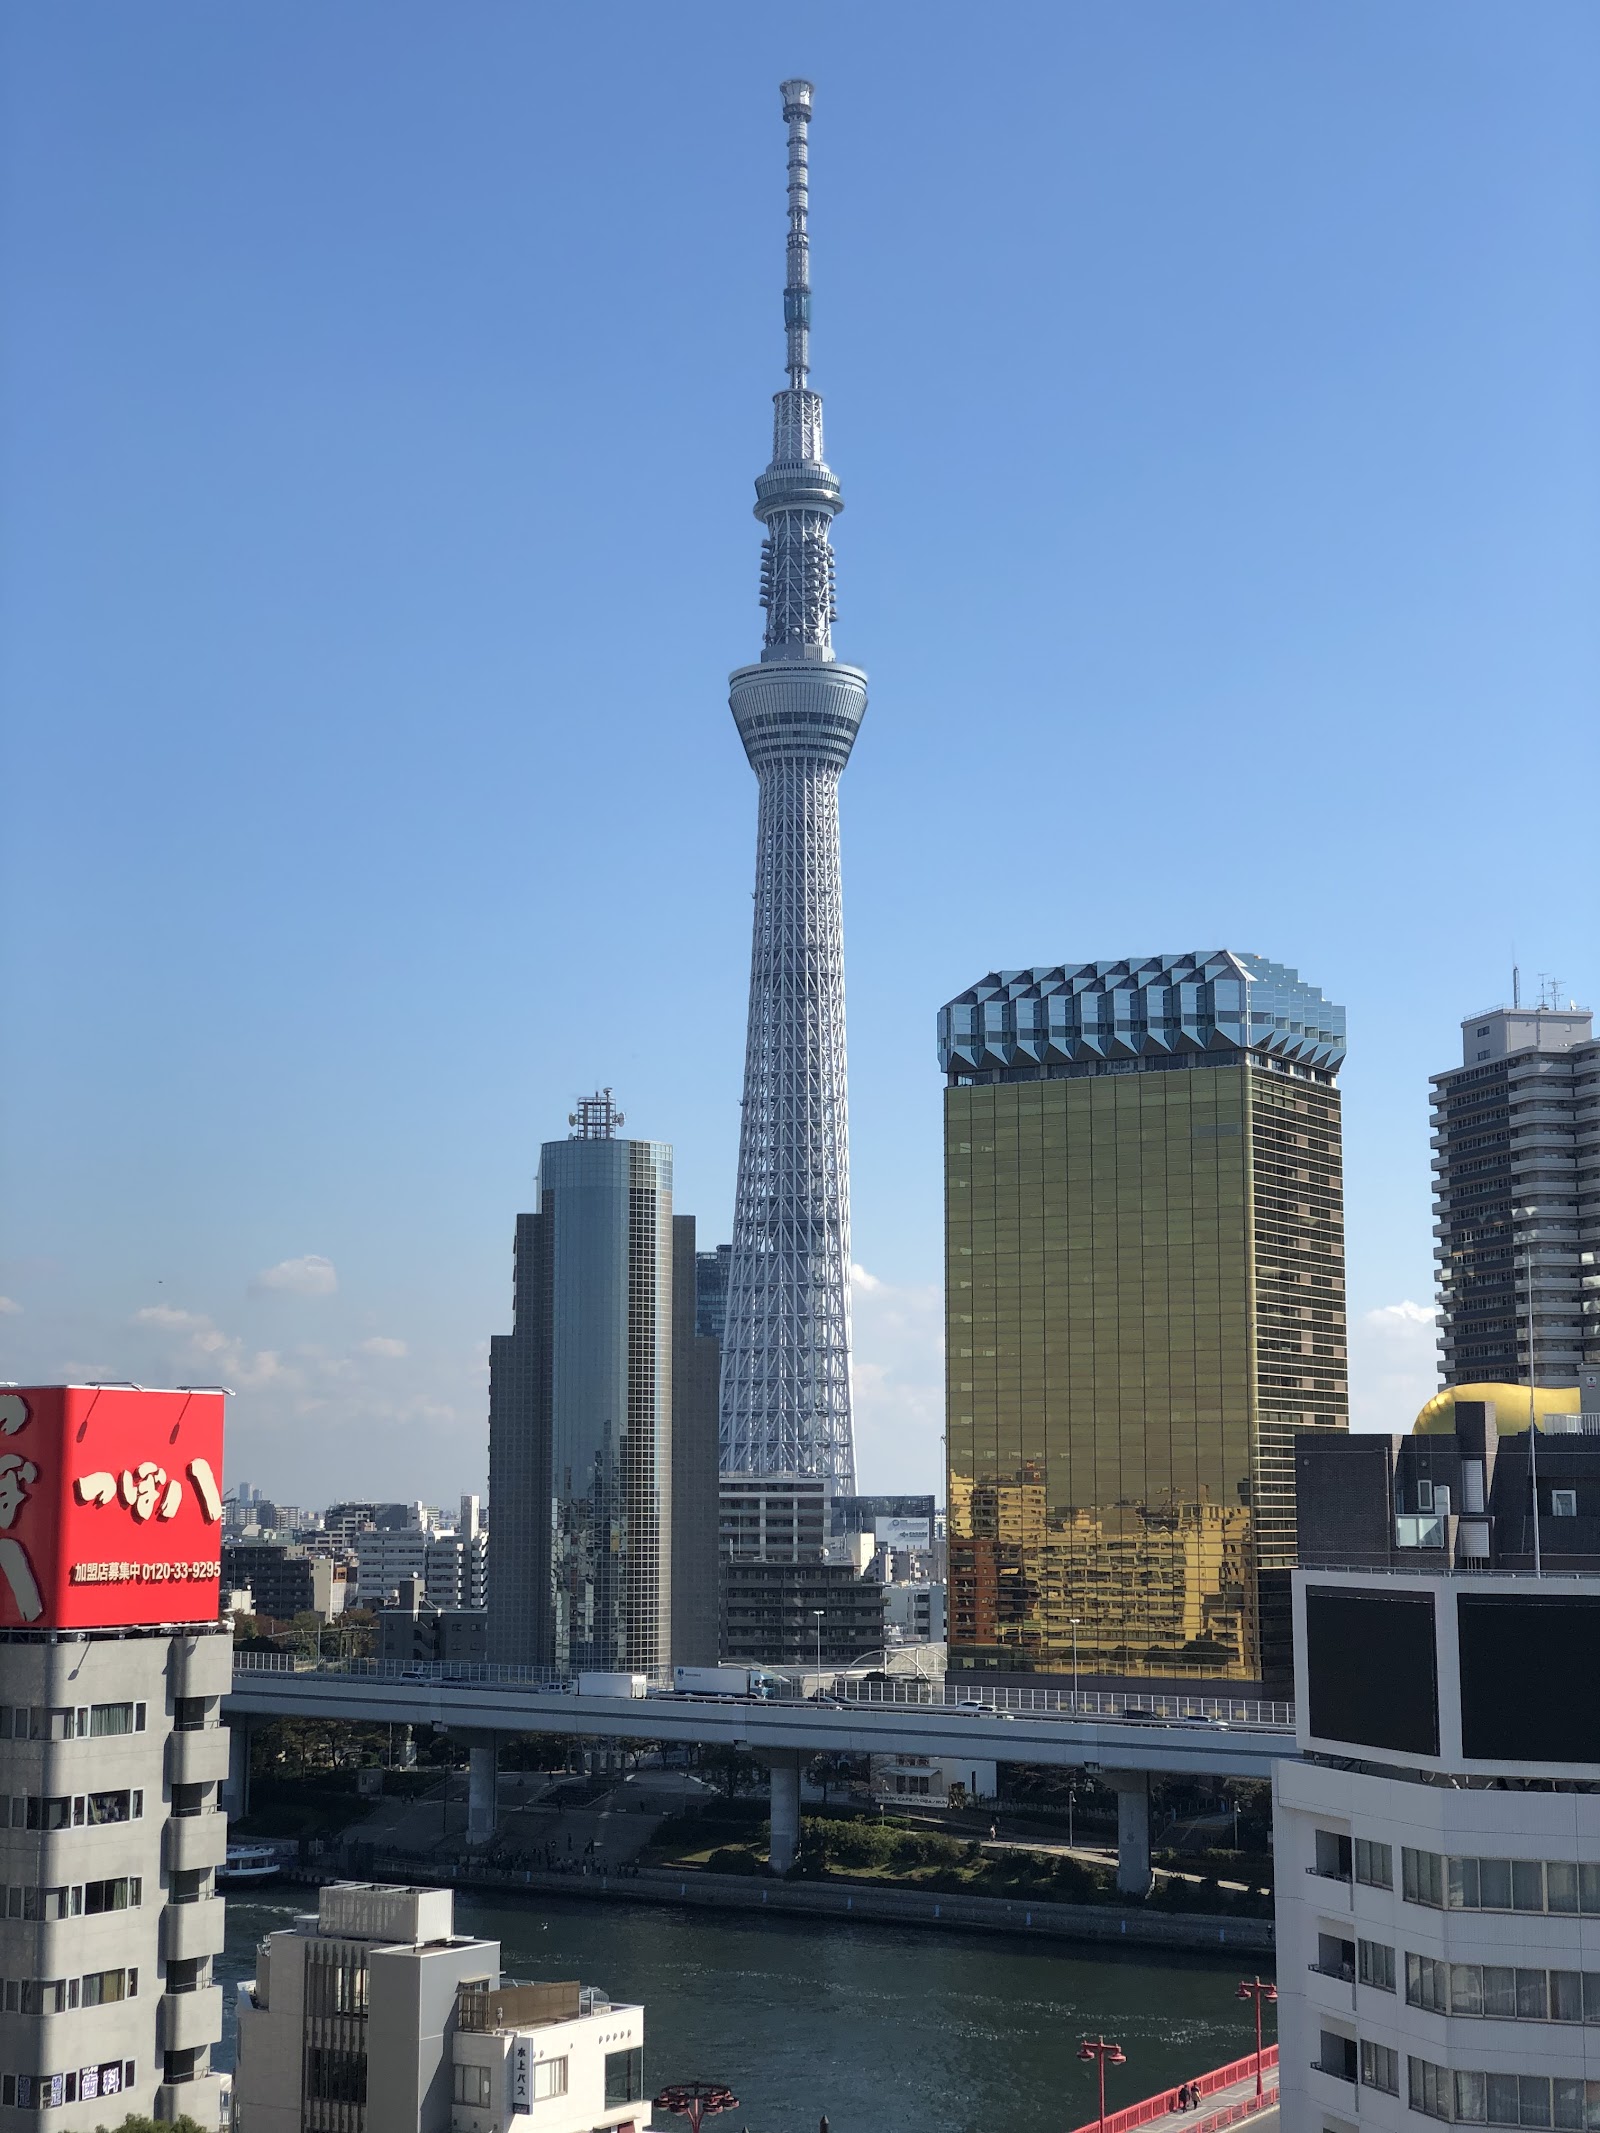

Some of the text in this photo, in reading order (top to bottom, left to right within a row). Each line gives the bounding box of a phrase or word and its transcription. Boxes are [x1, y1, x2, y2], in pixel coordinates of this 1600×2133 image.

[80, 1457, 222, 1521] つぼ八
[75, 1561, 221, 1581] 加盟店募集中 0120-33-9295
[82, 2067, 120, 2100] 歯科
[517, 2047, 526, 2096] 水上バス
